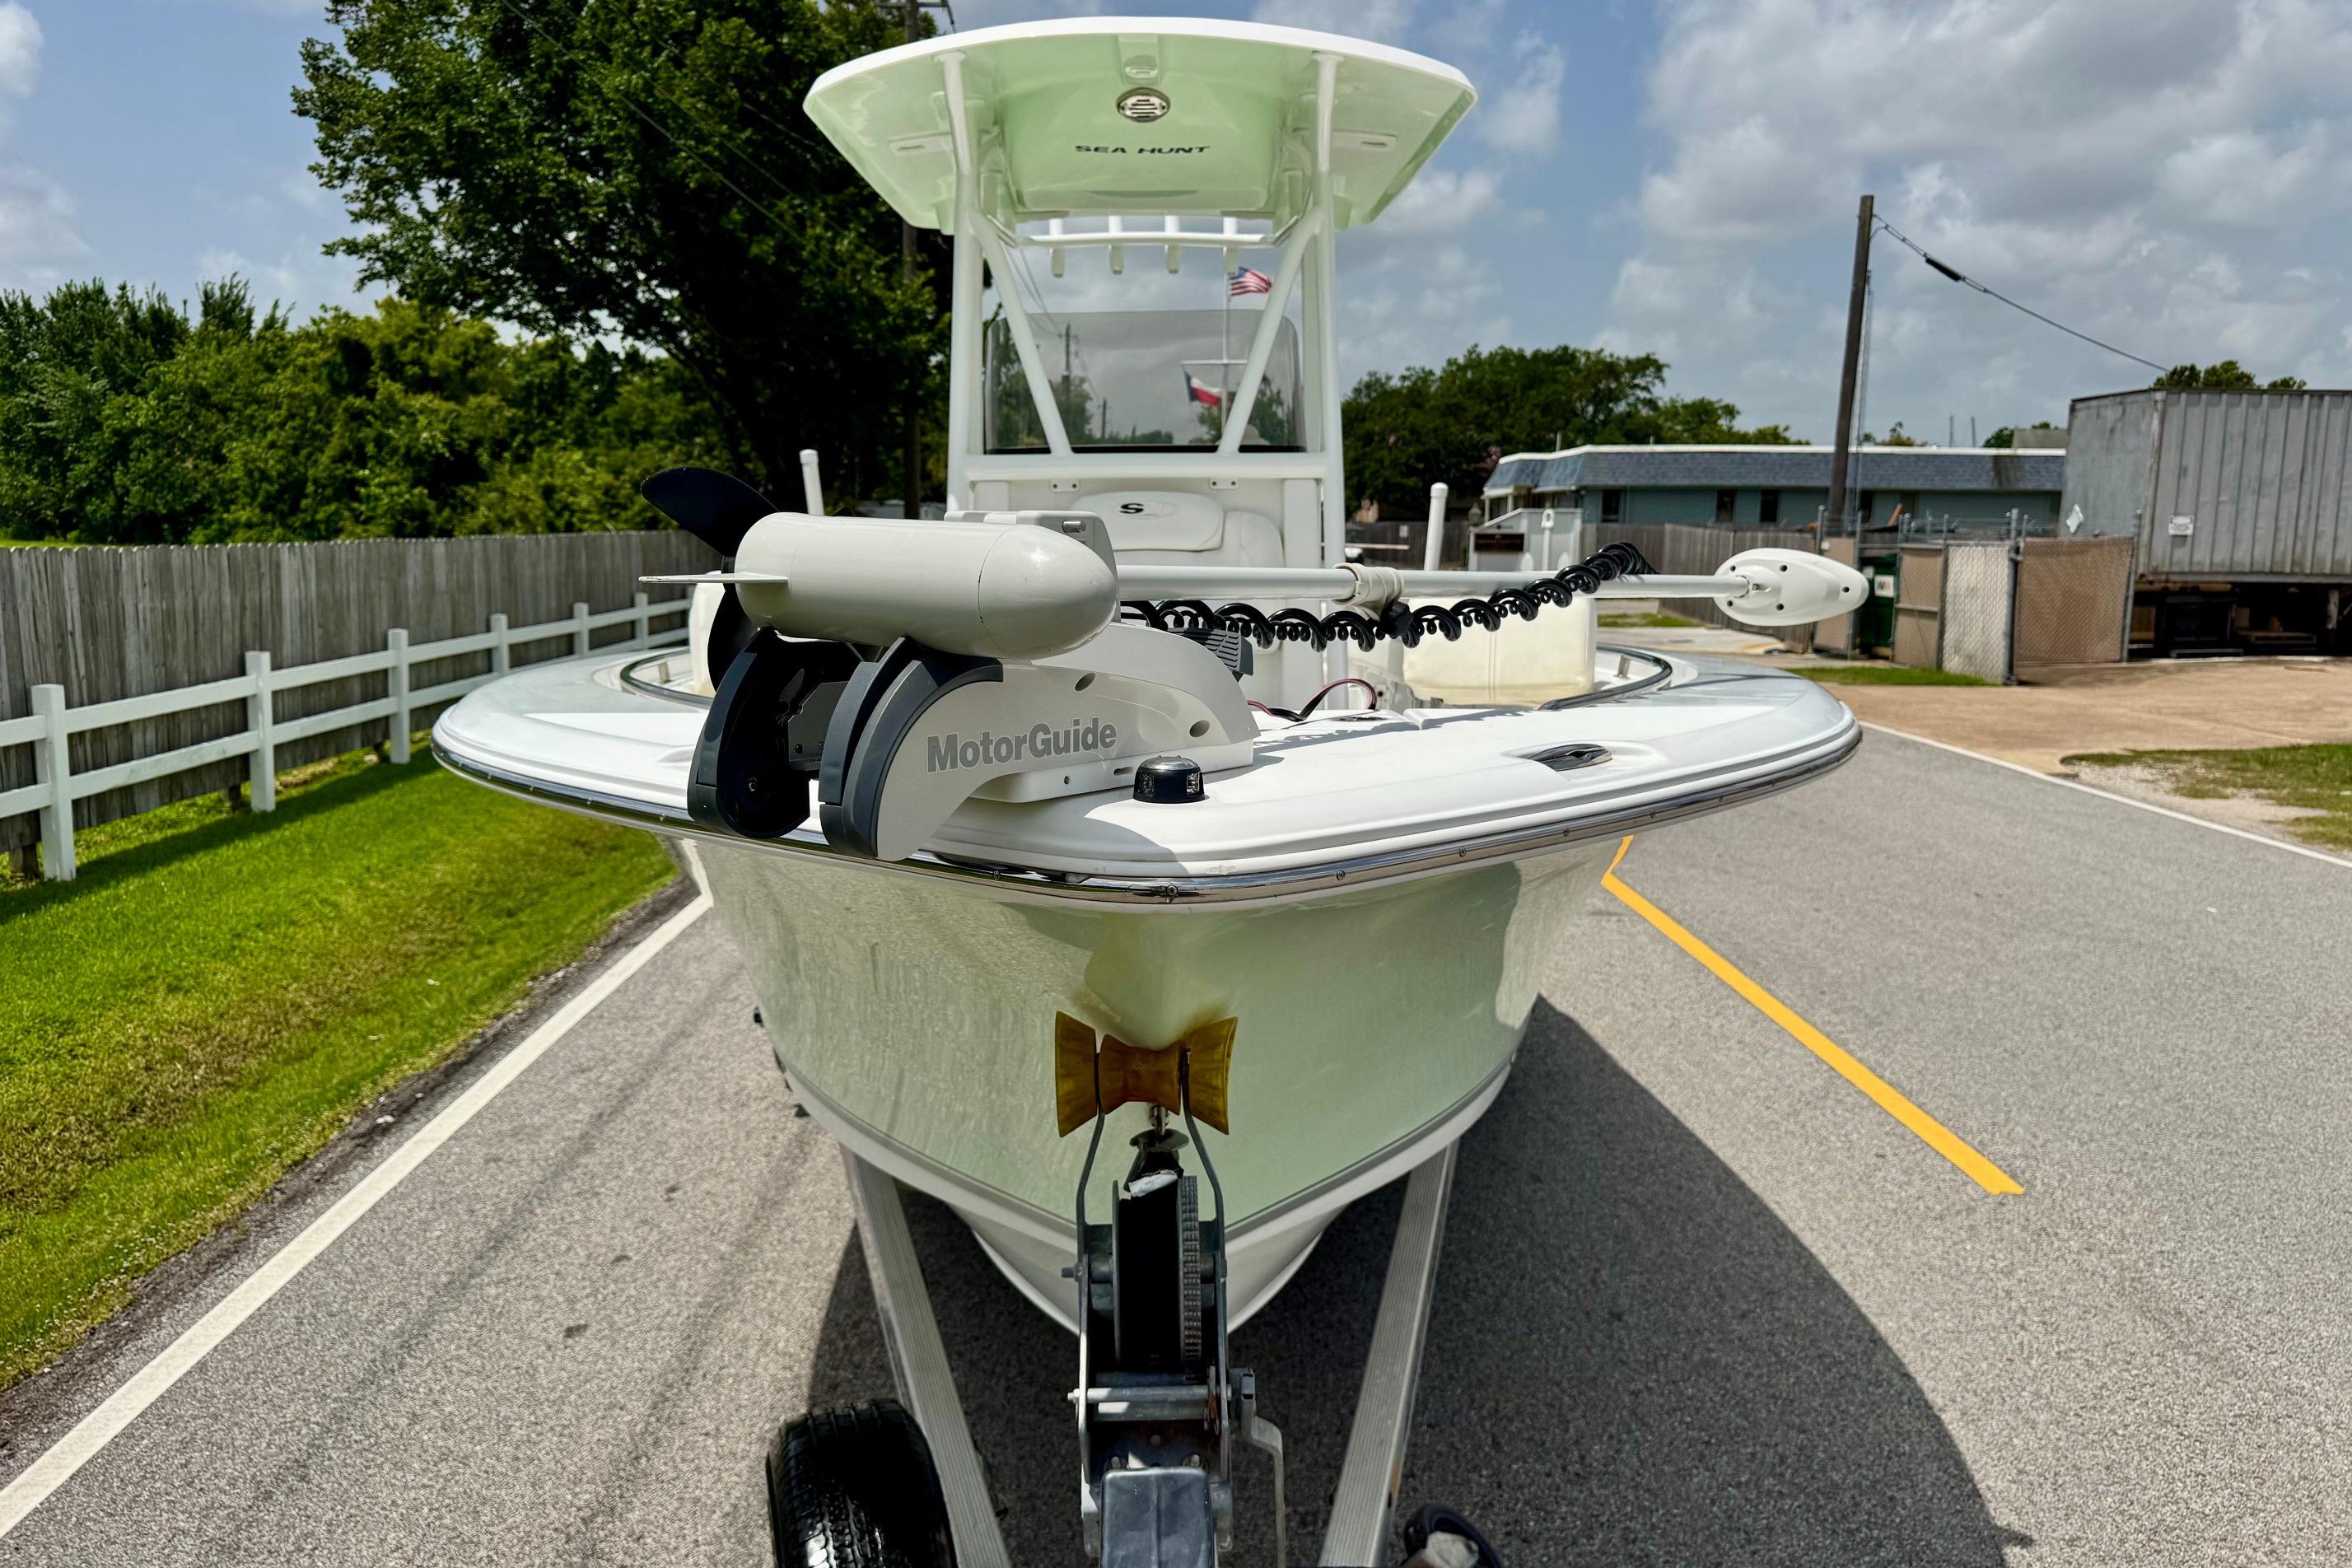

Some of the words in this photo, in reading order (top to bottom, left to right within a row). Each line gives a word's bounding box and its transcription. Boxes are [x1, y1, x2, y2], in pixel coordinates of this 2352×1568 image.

[1075, 145, 1127, 153] SEA
[1136, 146, 1211, 154] HUNT
[926, 716, 1118, 773] MotorGuide
